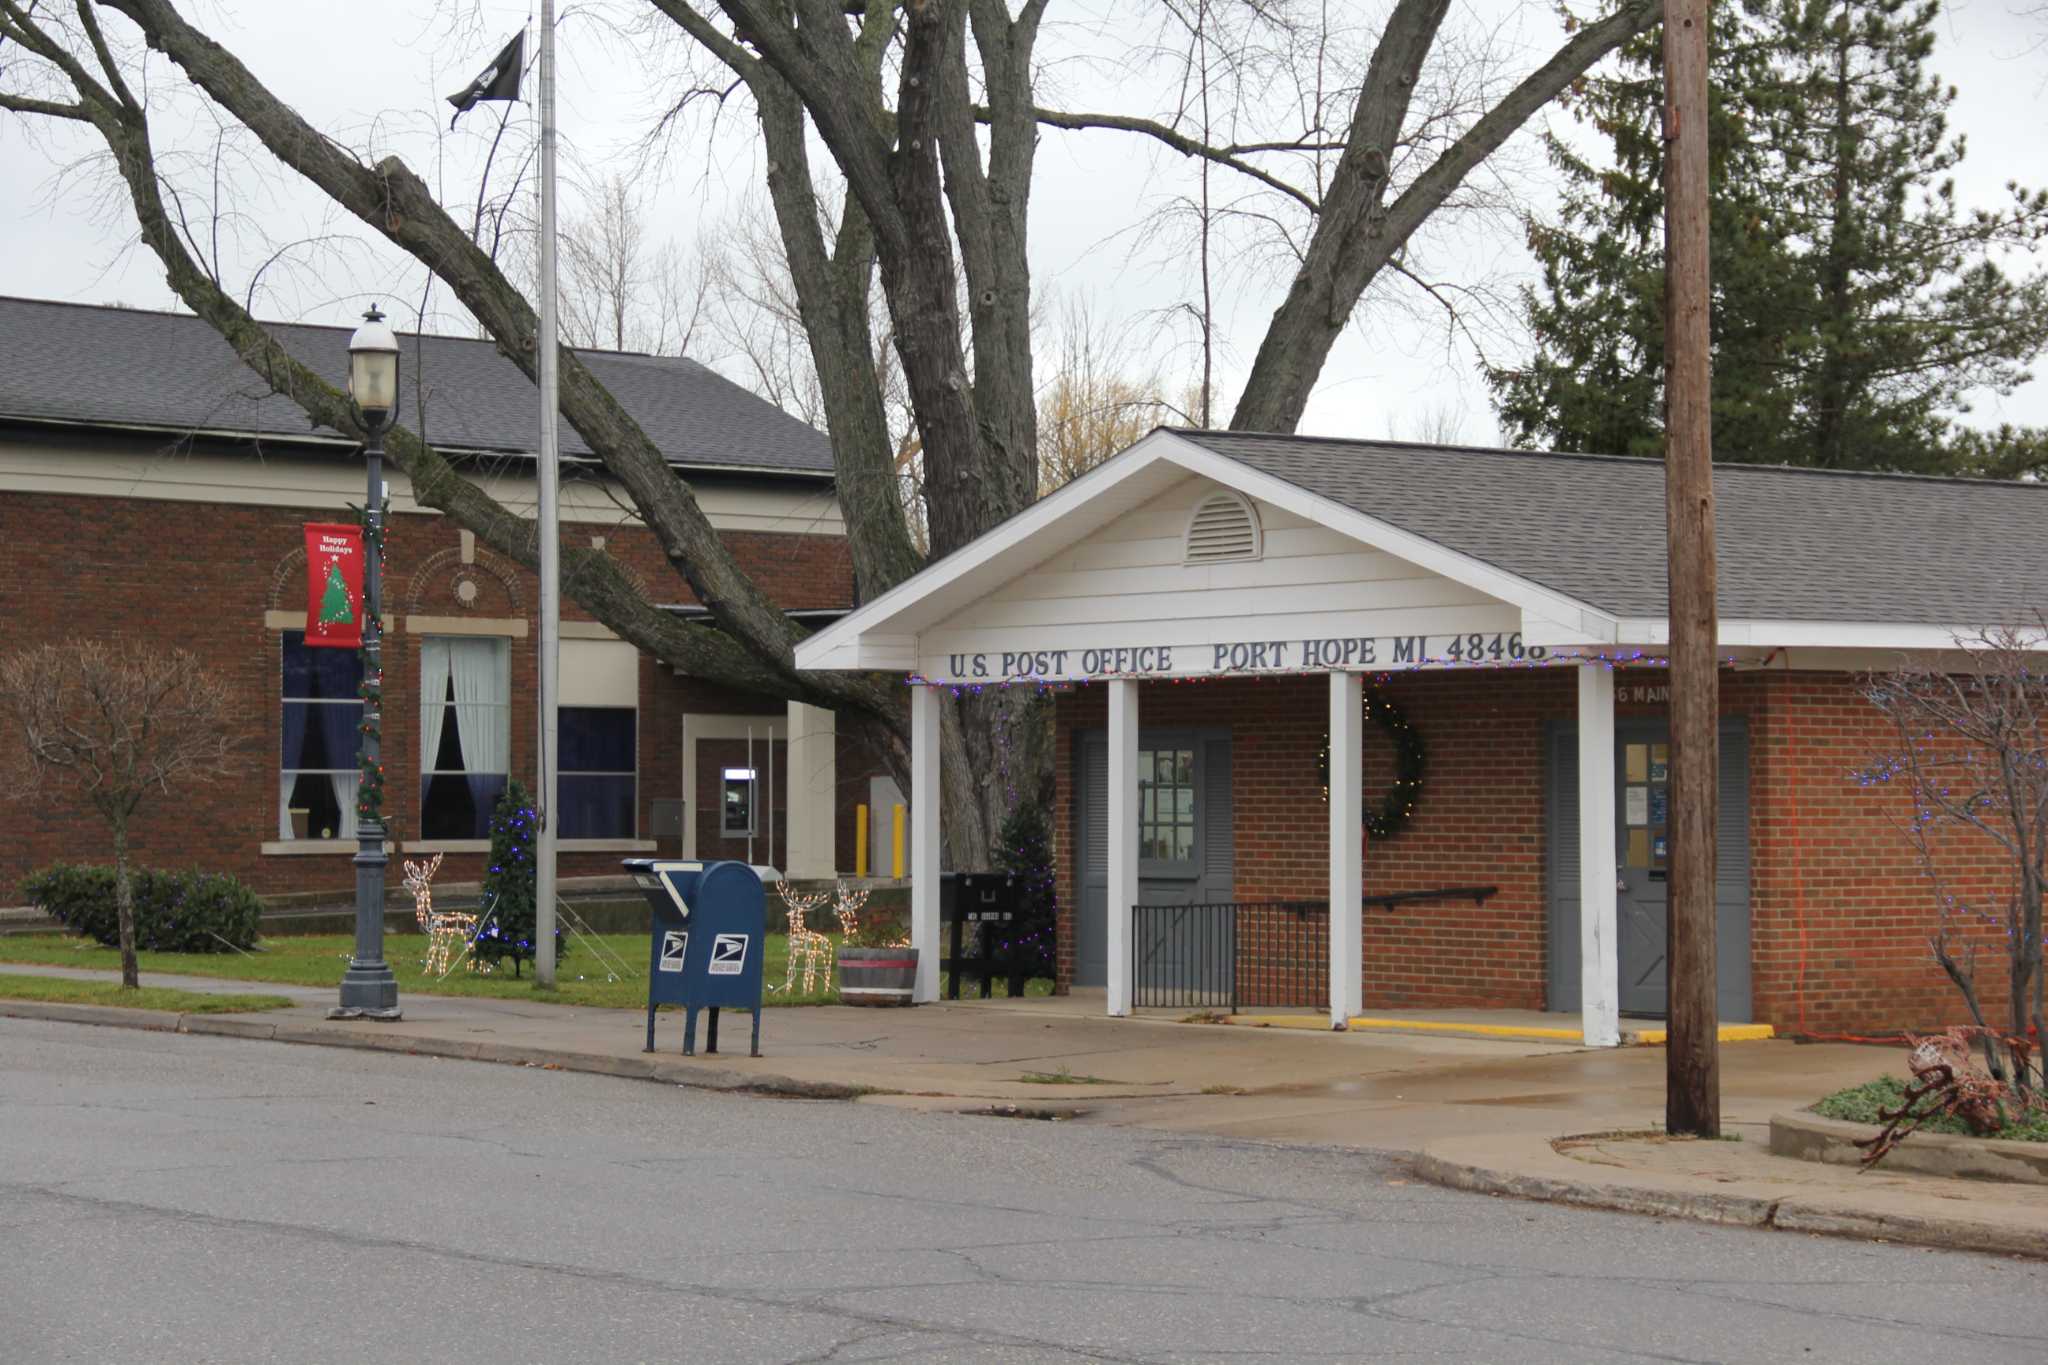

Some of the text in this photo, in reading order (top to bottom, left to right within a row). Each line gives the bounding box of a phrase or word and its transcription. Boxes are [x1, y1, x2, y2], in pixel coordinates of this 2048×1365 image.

[322, 536, 347, 545] Happy
[320, 544, 352, 554] Holidays
[950, 653, 989, 678] U.S.
[1001, 651, 1069, 677] POST
[1081, 646, 1173, 674] OFFICE
[1213, 640, 1288, 670] PORT
[1302, 637, 1377, 666] HOPE
[1392, 635, 1427, 663] MI
[1634, 685, 1670, 703] MAIN
